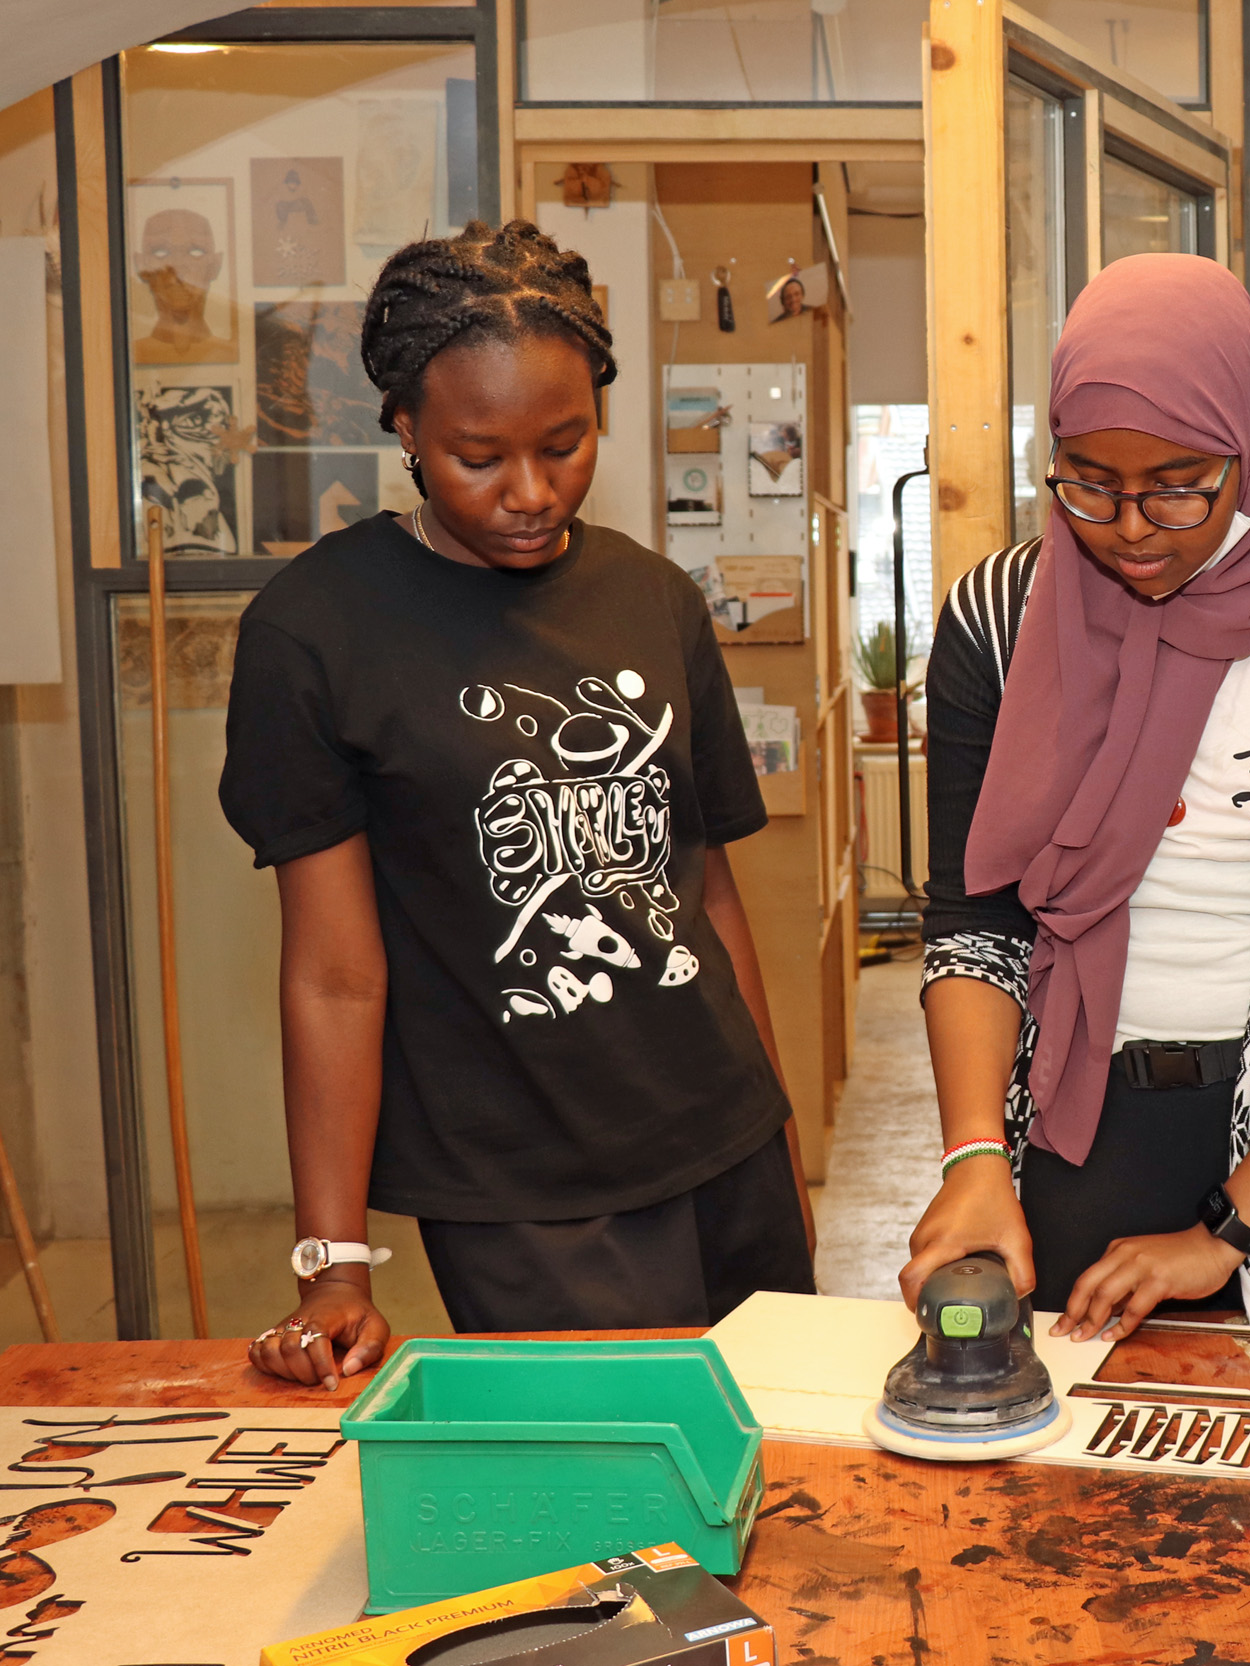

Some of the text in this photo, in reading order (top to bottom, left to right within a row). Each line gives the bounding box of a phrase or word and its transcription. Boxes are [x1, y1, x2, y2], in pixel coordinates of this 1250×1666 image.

[417, 1491, 669, 1525] SCHÄFER
[417, 1530, 572, 1551] LAGER-FIX
[652, 1548, 671, 1557] L
[288, 1627, 373, 1653] ARNOMED
[292, 1639, 354, 1662] NITRIL
[357, 1622, 421, 1644] BLACK
[426, 1600, 515, 1626] PREMIUM
[688, 1619, 757, 1641] ARNOWA
[744, 1641, 758, 1662] L
